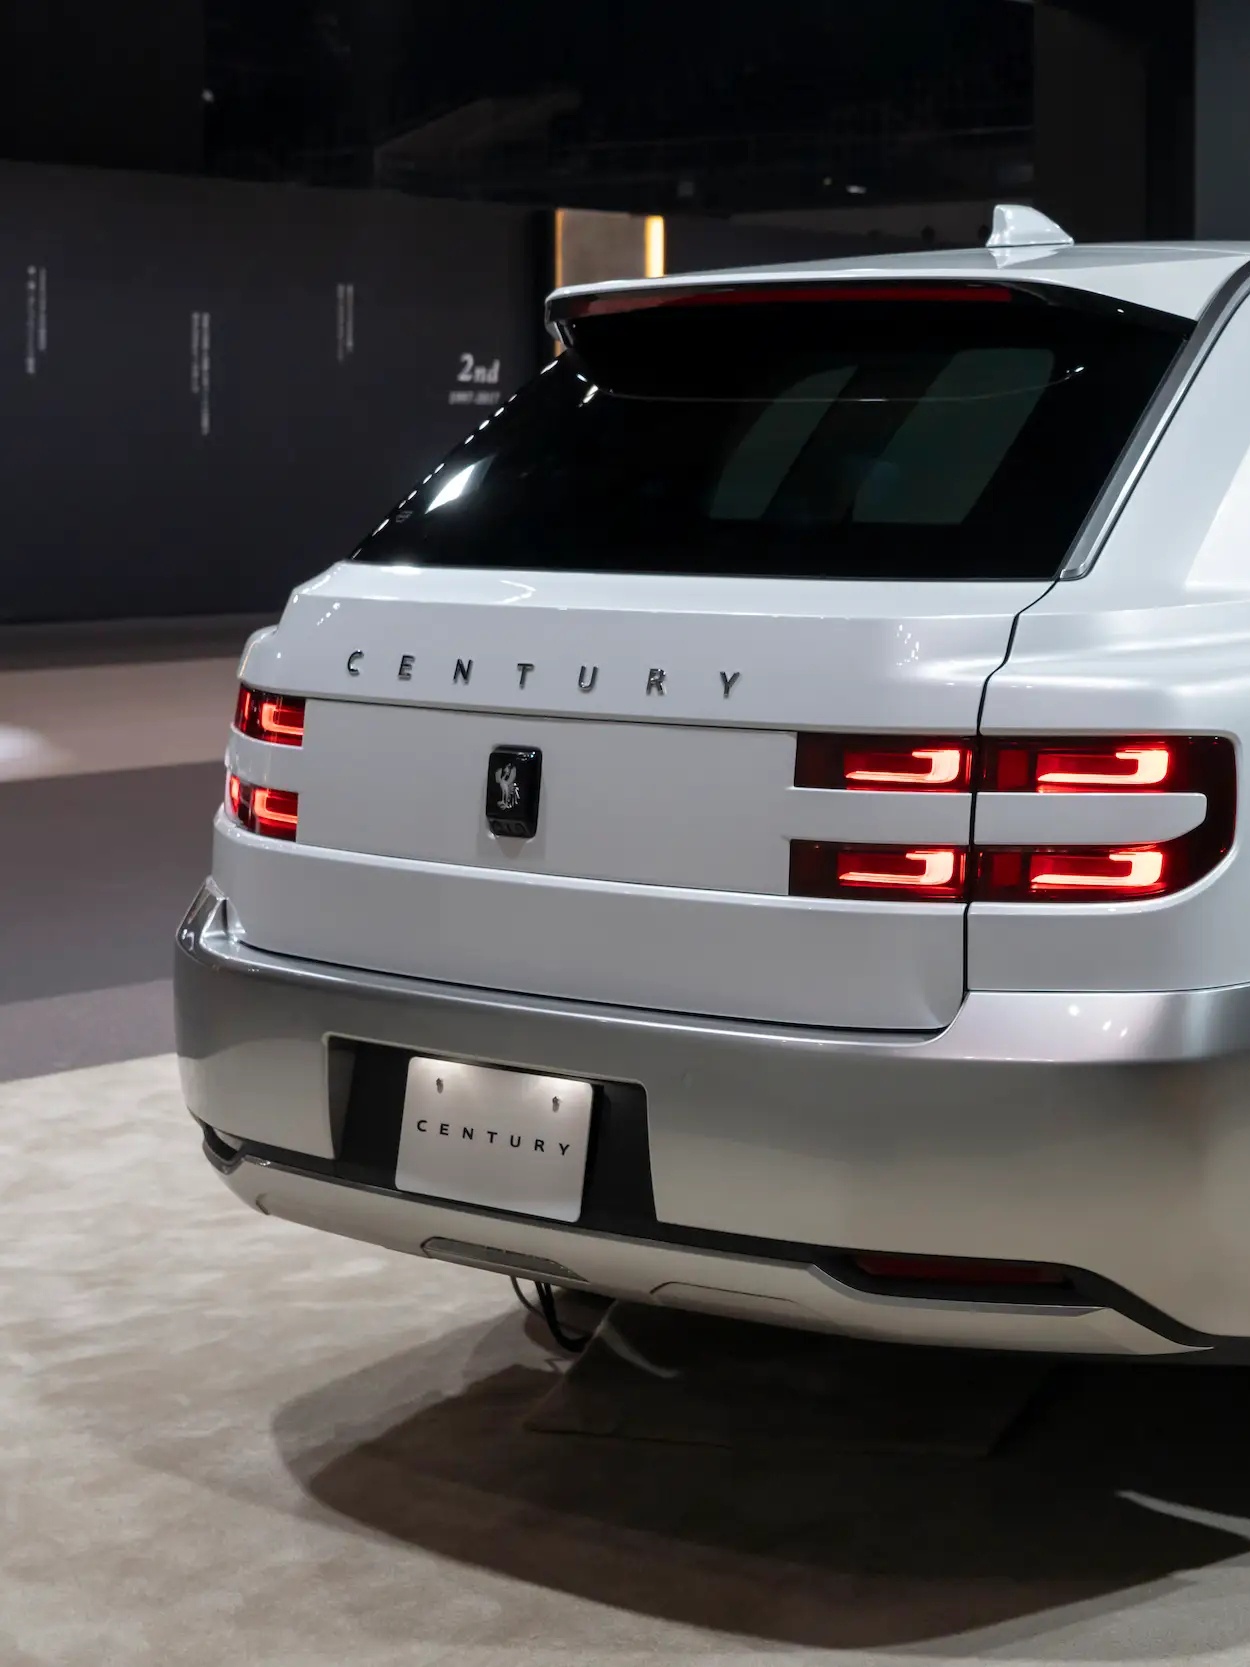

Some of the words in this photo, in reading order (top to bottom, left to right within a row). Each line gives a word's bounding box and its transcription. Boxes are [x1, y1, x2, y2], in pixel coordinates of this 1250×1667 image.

[457, 352, 501, 384] 2nd
[347, 649, 740, 697] CENTURY
[416, 1119, 570, 1156] CENTURY
